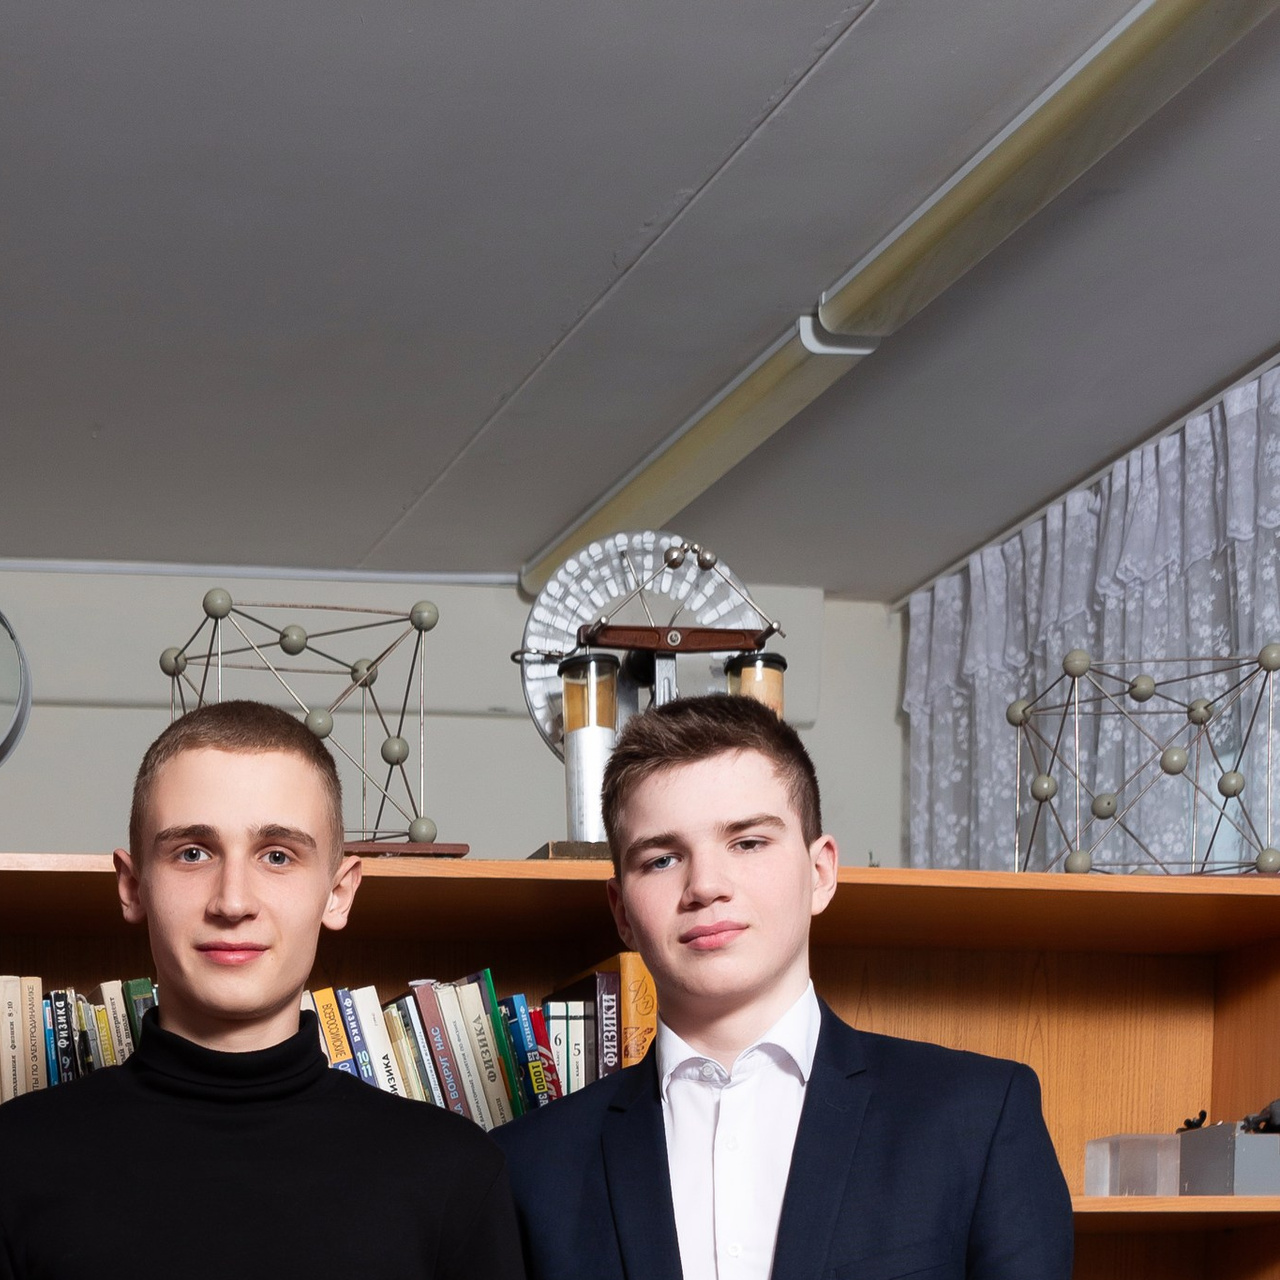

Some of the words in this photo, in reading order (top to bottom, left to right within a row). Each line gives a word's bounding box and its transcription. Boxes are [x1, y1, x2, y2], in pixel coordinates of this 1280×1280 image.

[27, 985, 38, 1062] ЭЛЕКТРОДИНАМИКЕ
[55, 1001, 70, 1048] Физика
[343, 998, 360, 1042] Физика
[431, 1026, 445, 1051] НАС
[519, 1006, 532, 1048] ФИЗИКА
[554, 1033, 562, 1046] 6
[602, 994, 618, 1067] ФИЗИКИ
[472, 1014, 497, 1083] ФИЗИКА
[573, 1043, 581, 1056] 5
[439, 1055, 459, 1099] ВОКРУГ
[531, 1064, 545, 1093] 1000
